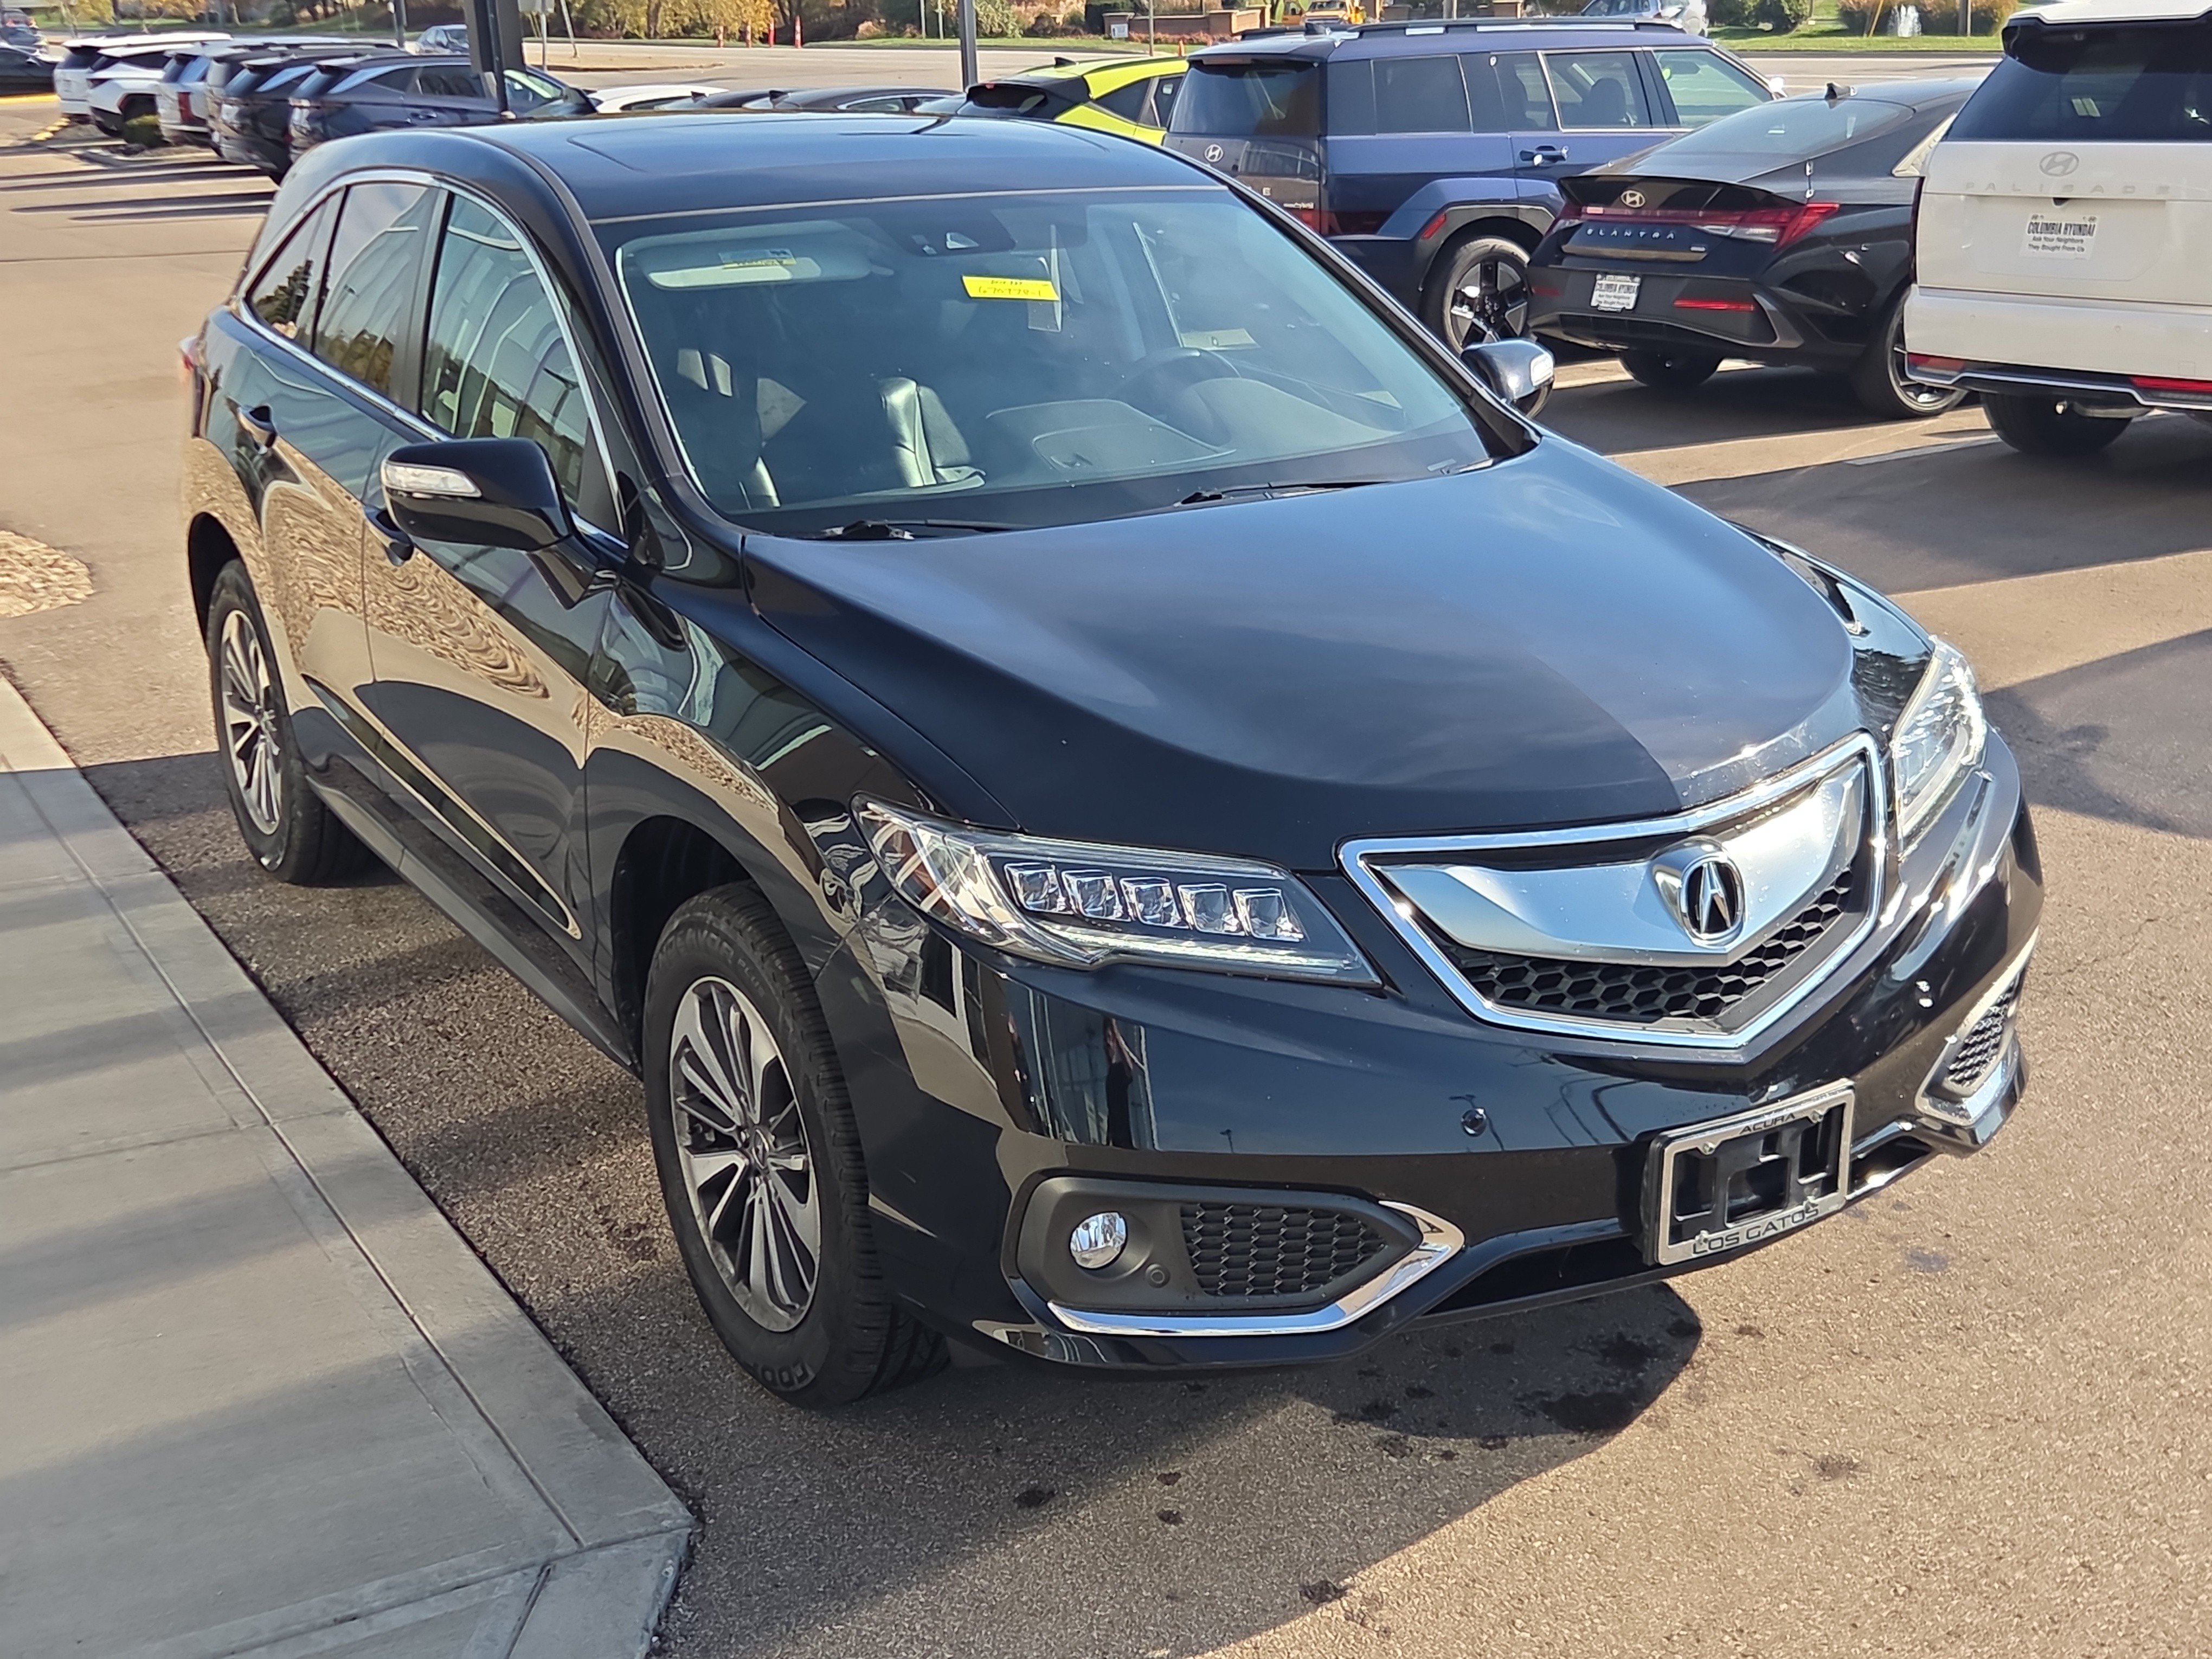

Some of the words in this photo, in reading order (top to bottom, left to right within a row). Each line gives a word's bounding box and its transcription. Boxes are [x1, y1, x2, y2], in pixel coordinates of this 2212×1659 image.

[1965, 182, 2171, 195] PALISADE
[1586, 228, 1675, 240] ELANTRA
[2063, 223, 2096, 237] HYUNDAI
[1740, 1113, 1796, 1134] ACURA
[1693, 1232, 1740, 1255] LOS
[1746, 1207, 1819, 1239] GATOS
